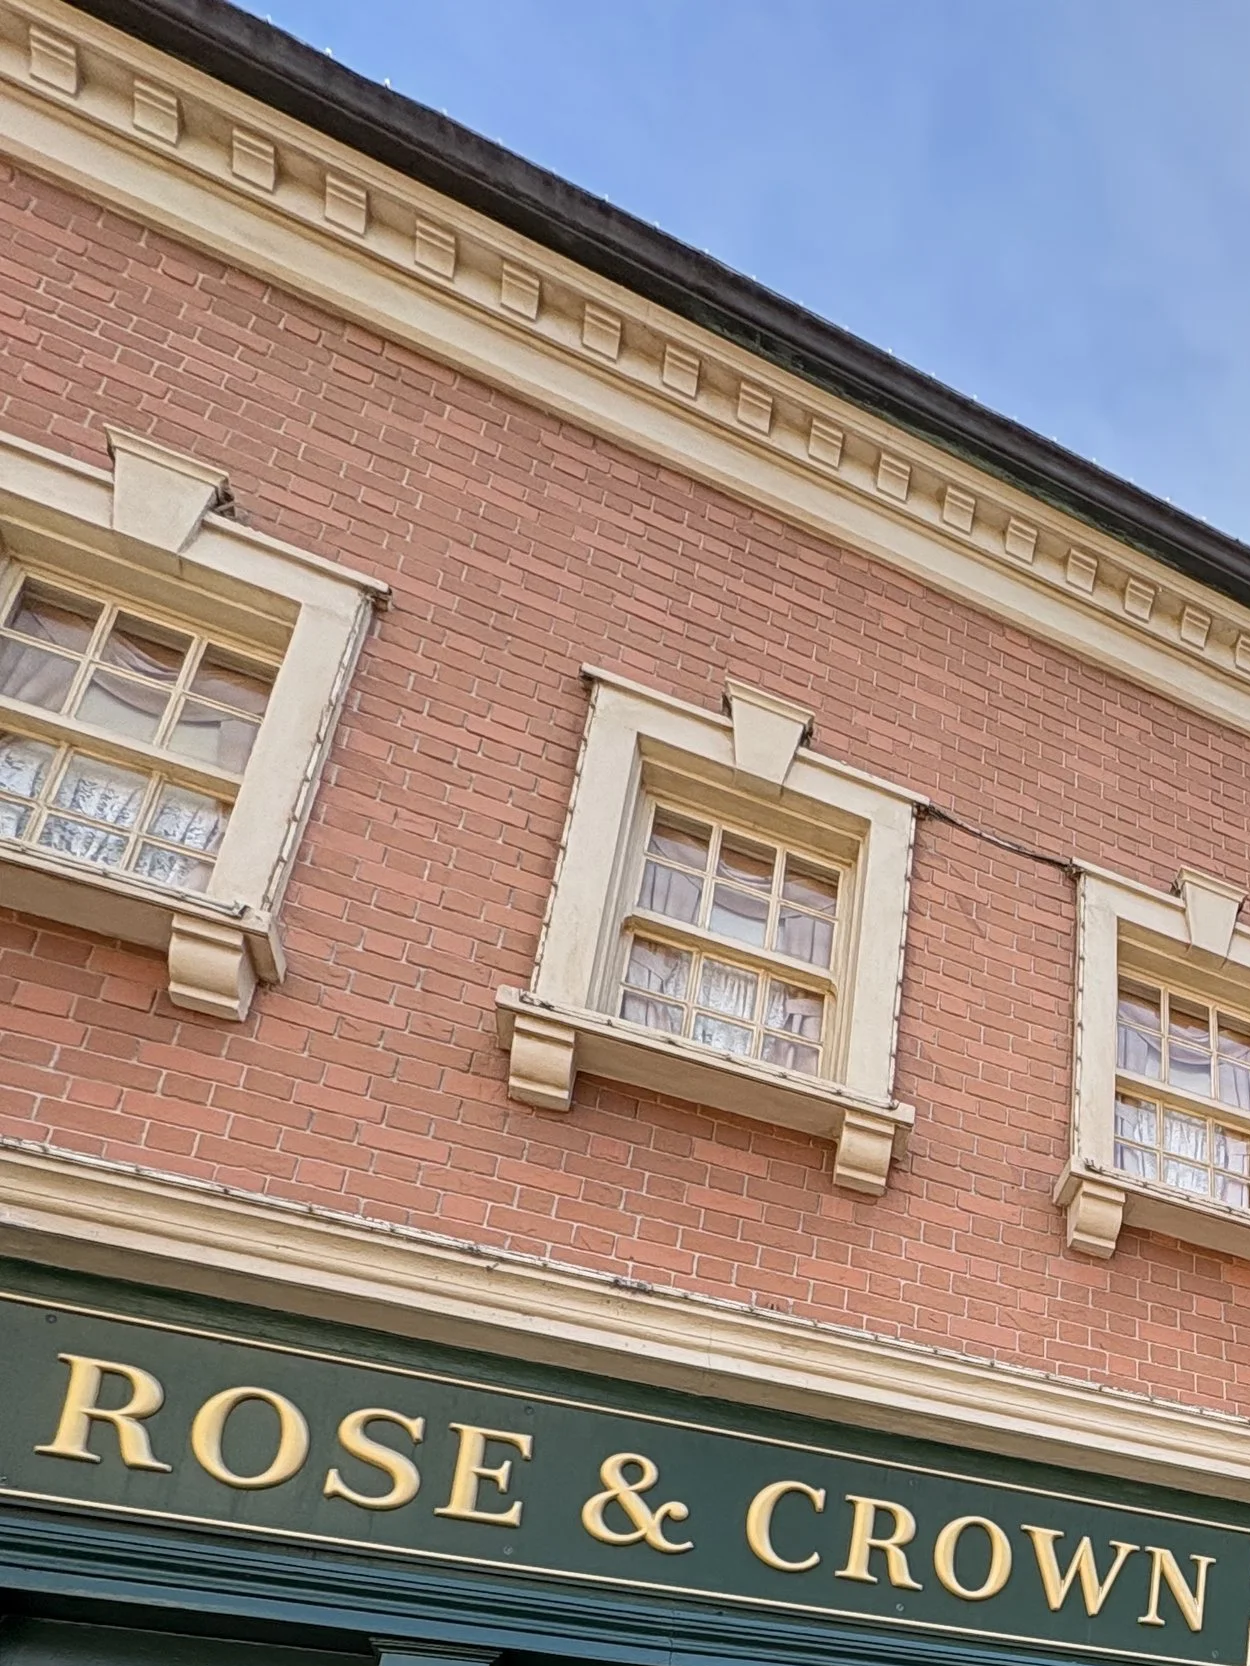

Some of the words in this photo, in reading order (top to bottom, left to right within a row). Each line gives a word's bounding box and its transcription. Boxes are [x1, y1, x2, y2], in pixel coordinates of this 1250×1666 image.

[34, 1353, 533, 1528] ROSE
[581, 1452, 694, 1554] &
[746, 1480, 1216, 1632] CROWN
